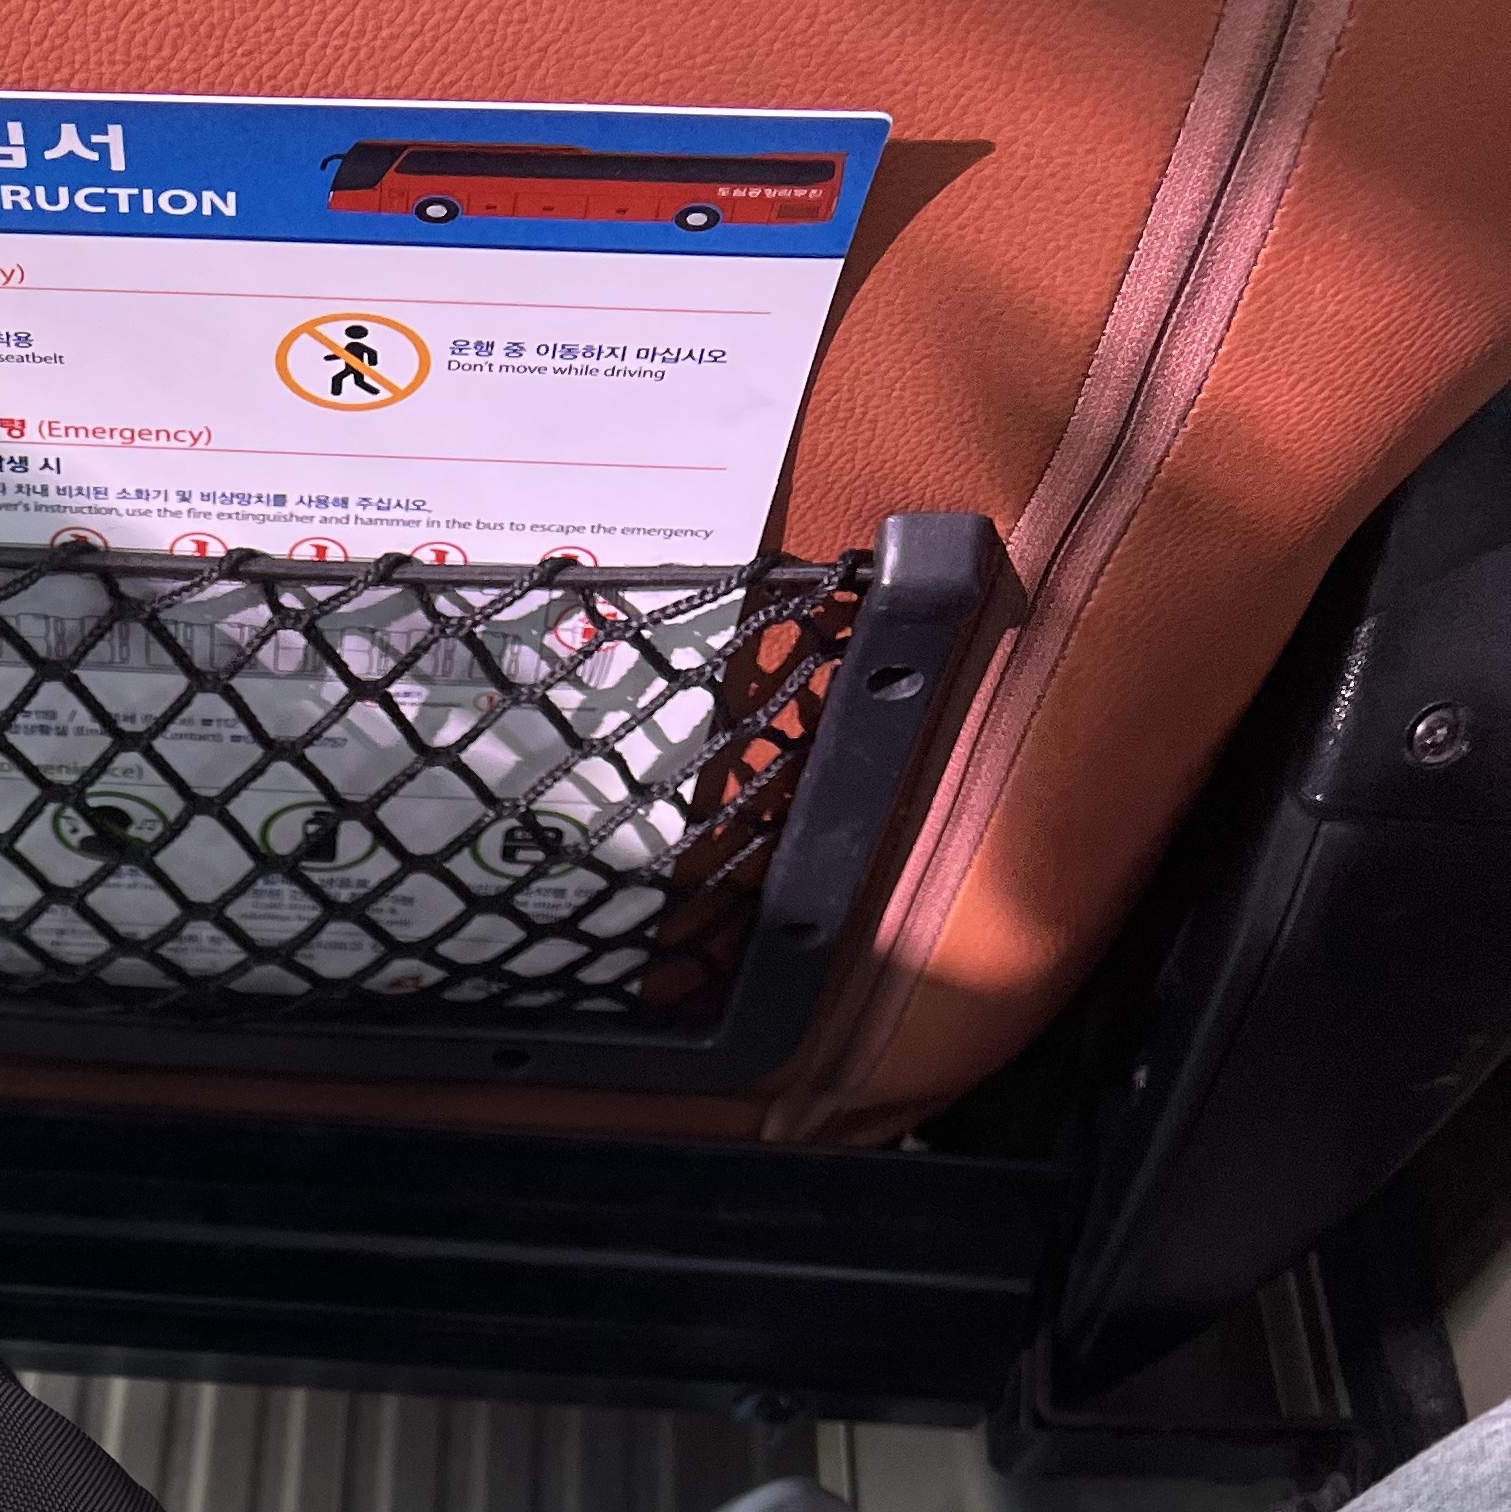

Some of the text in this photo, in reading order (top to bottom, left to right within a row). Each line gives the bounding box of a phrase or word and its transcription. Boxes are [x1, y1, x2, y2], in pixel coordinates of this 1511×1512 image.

[448, 338, 728, 366] 운행 중 이동하지 마십시오
[447, 359, 666, 382] Don't move while driving
[38, 419, 212, 447] (Emergency)
[39, 456, 62, 475] 시
[126, 507, 153, 518] use
[157, 506, 183, 520] the
[188, 507, 212, 521] fire
[216, 509, 316, 525] extinguisher
[319, 513, 350, 526] and
[354, 514, 421, 529] hammer
[426, 517, 441, 530] in
[445, 518, 472, 531] the
[476, 519, 504, 532] bus
[509, 520, 526, 532] to
[530, 522, 586, 536] escape
[590, 522, 617, 535] the
[621, 526, 714, 541] emergency
